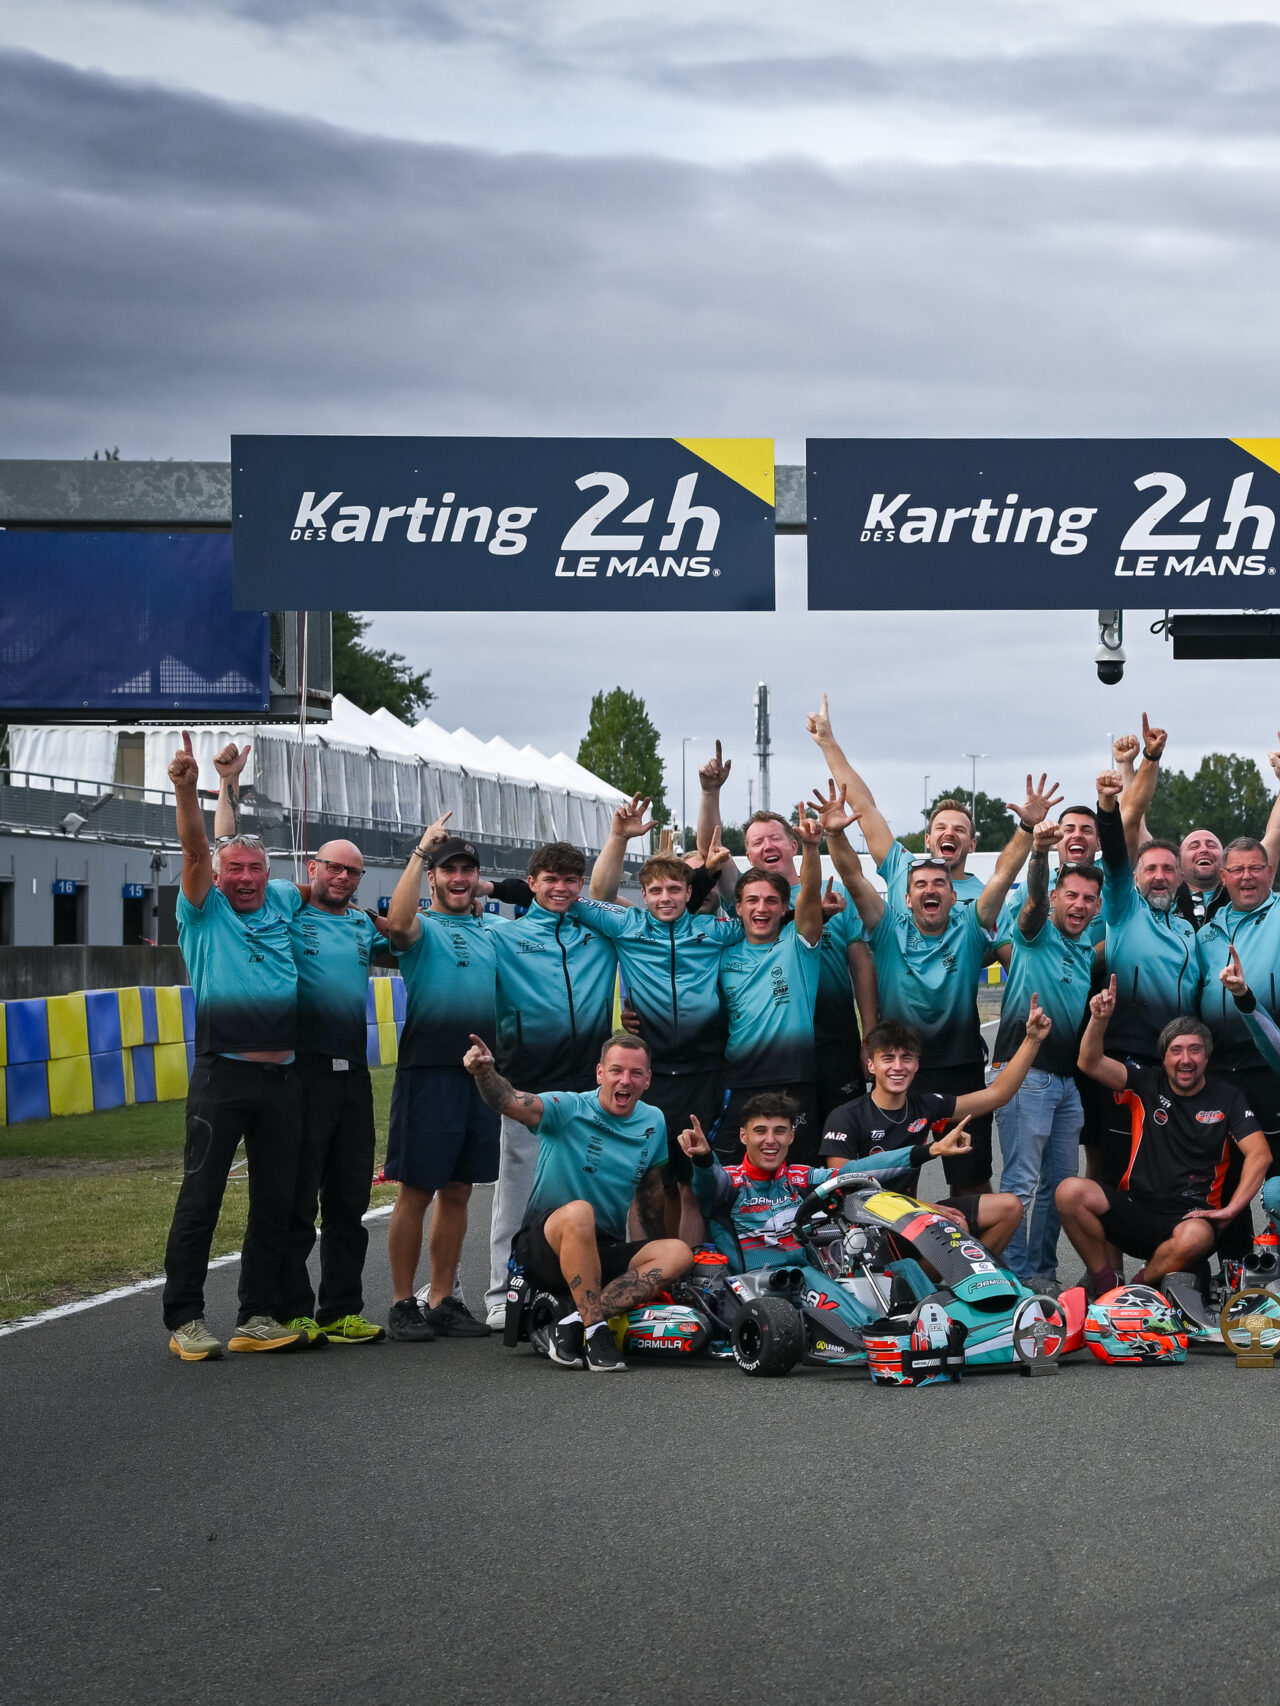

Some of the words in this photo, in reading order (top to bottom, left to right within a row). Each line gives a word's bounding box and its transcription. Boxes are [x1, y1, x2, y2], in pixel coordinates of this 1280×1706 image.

[561, 471, 721, 551] 24h
[1120, 471, 1276, 551] 24h
[294, 491, 537, 555] Karting
[865, 494, 1098, 555] Karting
[290, 529, 327, 541] DES
[860, 530, 895, 543] DES
[555, 557, 600, 577] LE
[605, 556, 713, 577] MANS
[1114, 555, 1158, 576] LE
[1163, 555, 1267, 576] MANS
[59, 881, 73, 893] 16
[129, 885, 142, 897] 15
[489, 903, 496, 912] 8
[773, 986, 789, 995] OMP
[629, 1338, 693, 1352] FORMULAK
[739, 1360, 760, 1371] LECONT
